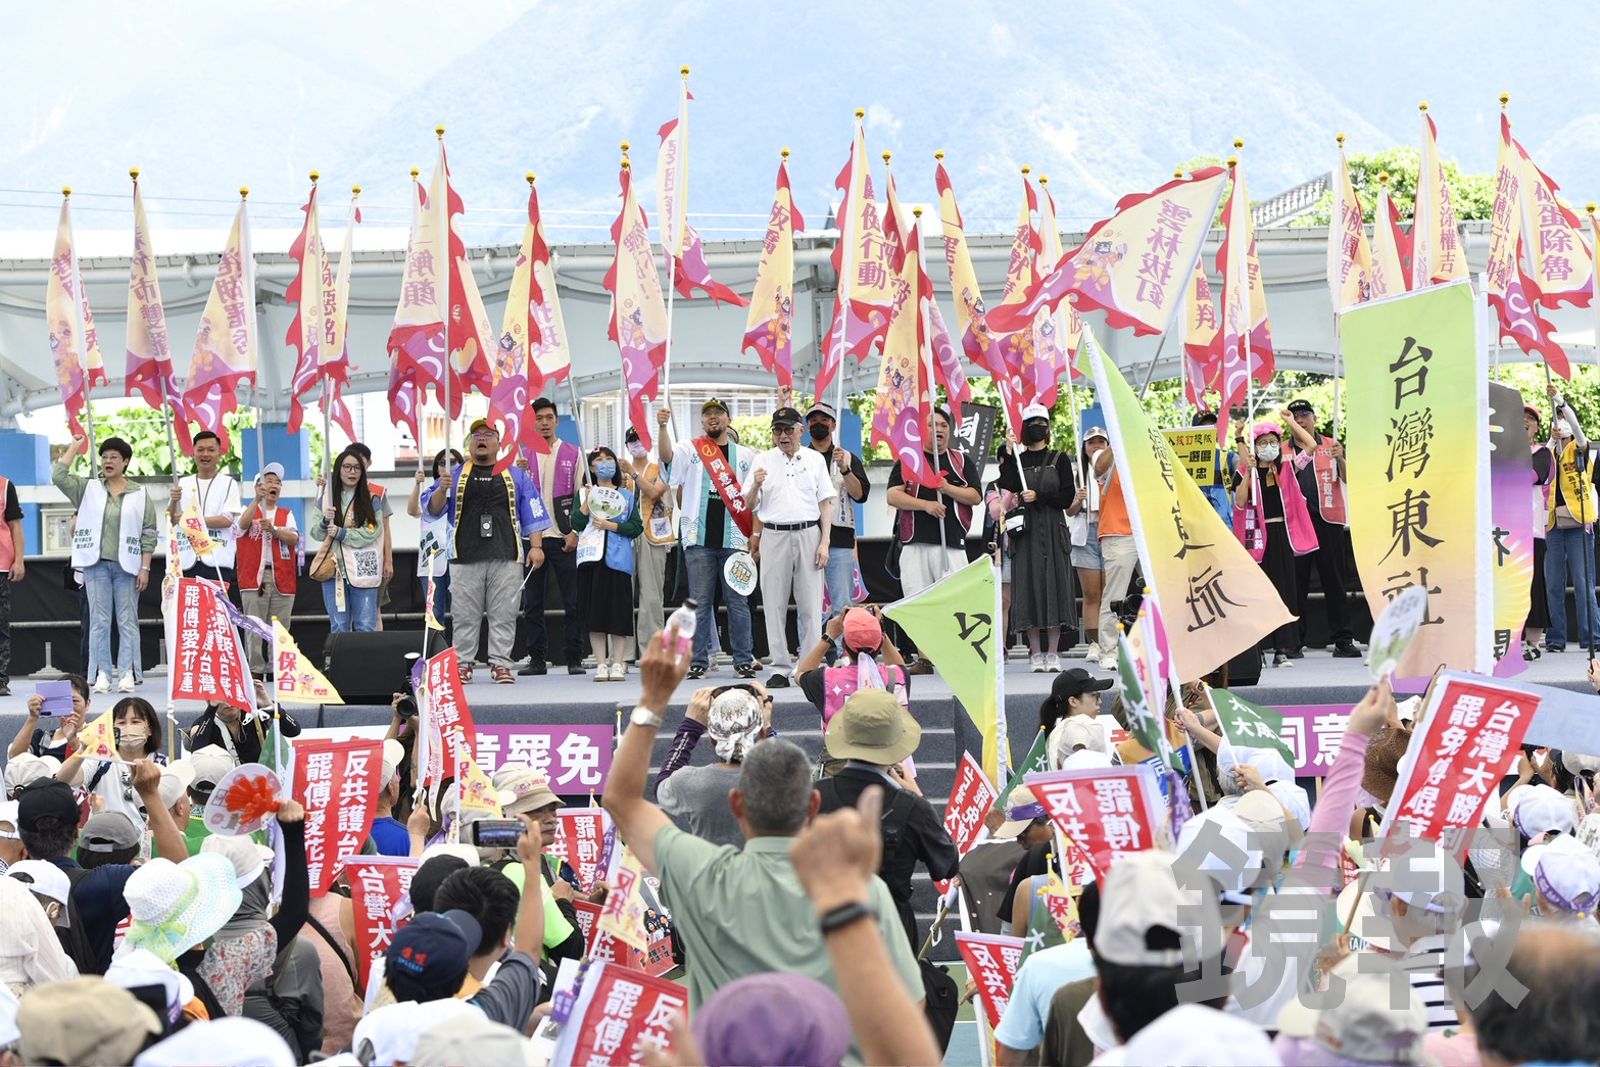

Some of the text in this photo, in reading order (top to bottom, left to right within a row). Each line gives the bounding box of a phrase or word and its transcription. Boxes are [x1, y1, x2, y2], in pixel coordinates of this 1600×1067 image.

[709, 458, 746, 513] 同意罷免
[1378, 336, 1446, 627] 台灣東社
[278, 651, 298, 692] 保台
[332, 750, 372, 874] 反共護台
